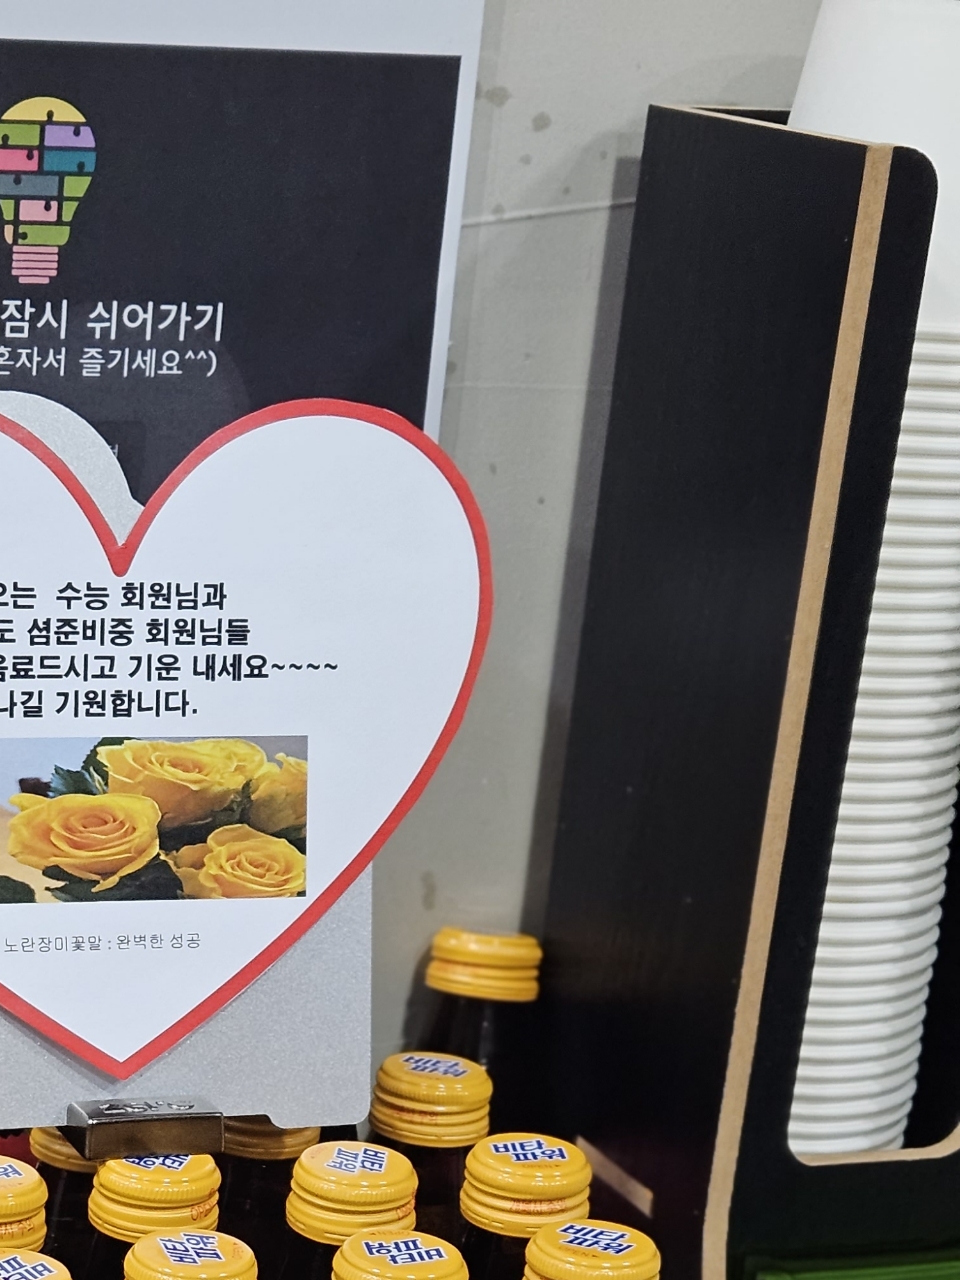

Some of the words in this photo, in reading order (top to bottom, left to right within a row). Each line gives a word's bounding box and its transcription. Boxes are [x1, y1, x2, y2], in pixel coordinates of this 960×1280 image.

[0, 298, 68, 340] 잠시
[86, 300, 224, 342] 쉬어가기
[56, 582, 110, 610] 수능
[121, 581, 228, 611] 회원님과
[27, 617, 135, 647] 셤준비중
[145, 617, 251, 647] 회원님들
[128, 653, 181, 682] 기운
[55, 689, 198, 718] 기원합니다.
[4, 935, 103, 953] 노란장미꽃말
[116, 933, 165, 950] 완벽한
[169, 932, 201, 949] 성공
[491, 1140, 544, 1153] 비타
[513, 1148, 568, 1161] 파워
[558, 1223, 627, 1242] 비타
[562, 1234, 635, 1254] 파워
[160, 1236, 201, 1265] 비타
[184, 1233, 225, 1261] 파워
[364, 1238, 423, 1256] 파워
[388, 1247, 447, 1265] 비타
